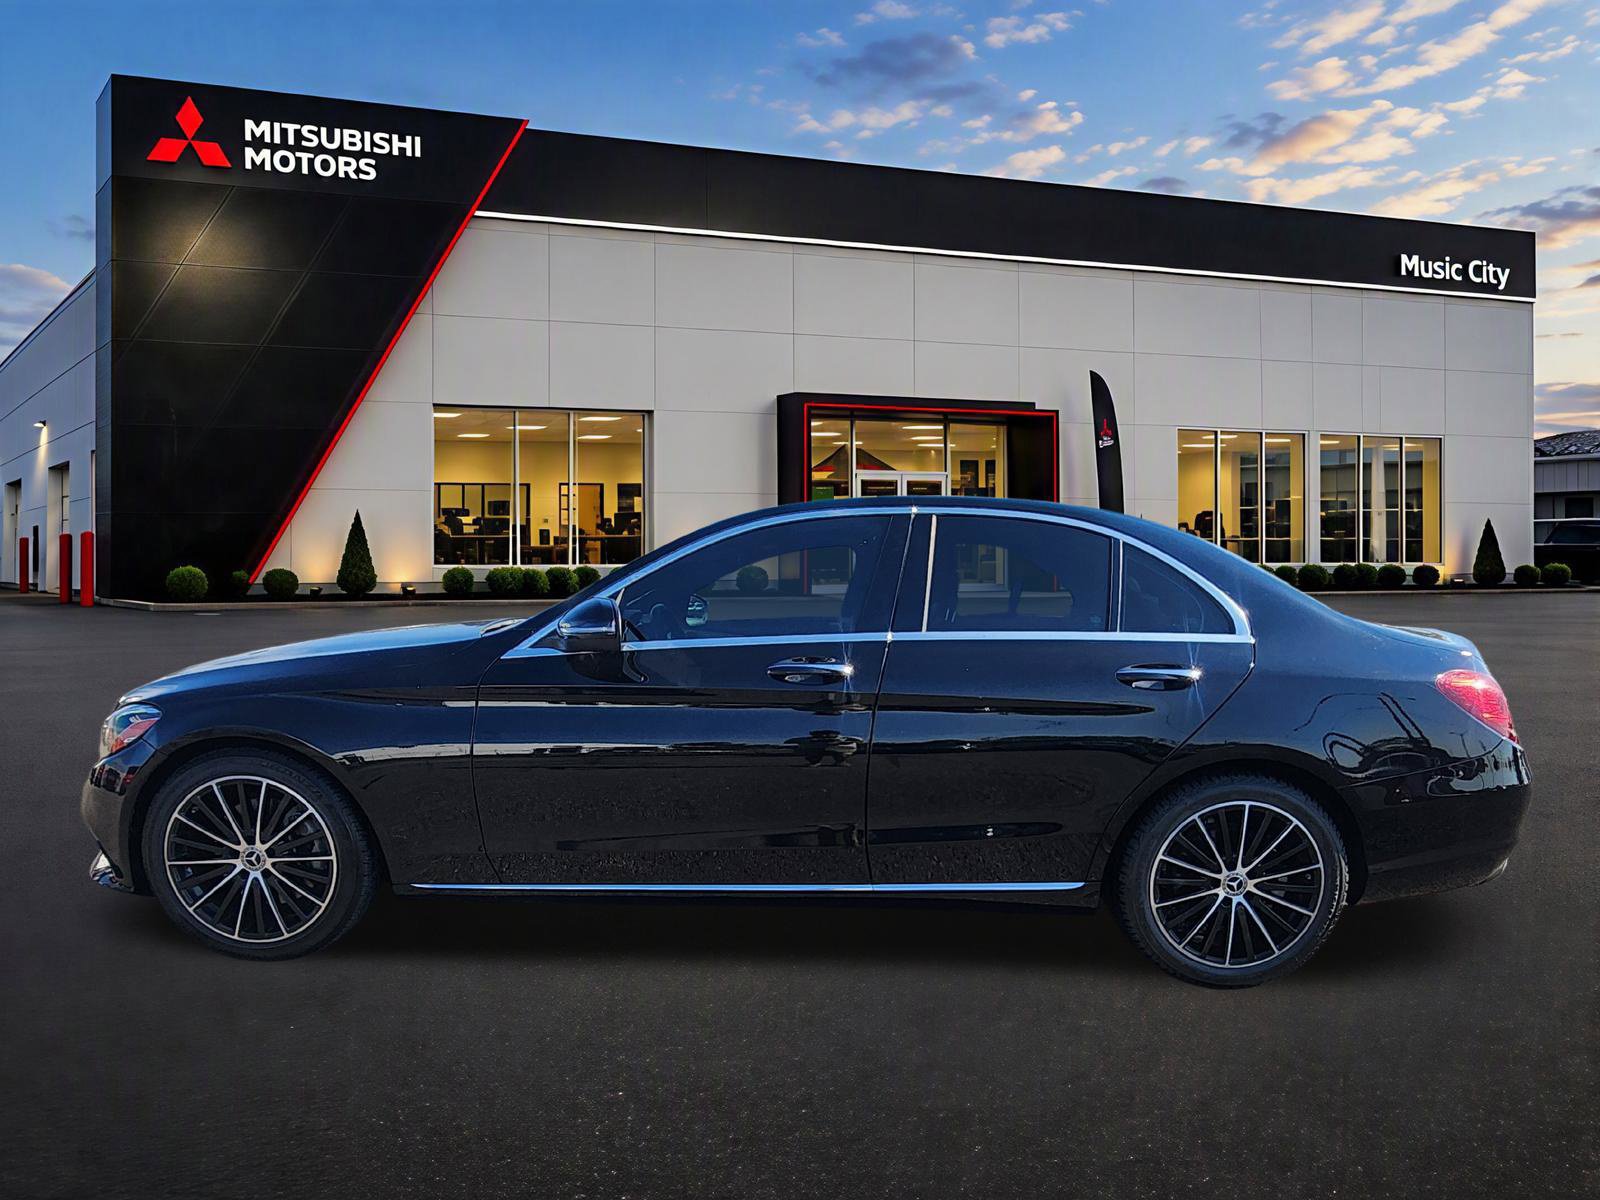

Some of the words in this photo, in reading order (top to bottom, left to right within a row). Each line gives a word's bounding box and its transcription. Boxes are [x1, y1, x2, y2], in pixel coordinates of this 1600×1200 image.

[244, 118, 422, 158] MITSUBISHI
[244, 146, 377, 181] MOTORS
[1400, 253, 1463, 281] Music
[1468, 259, 1511, 290] City
